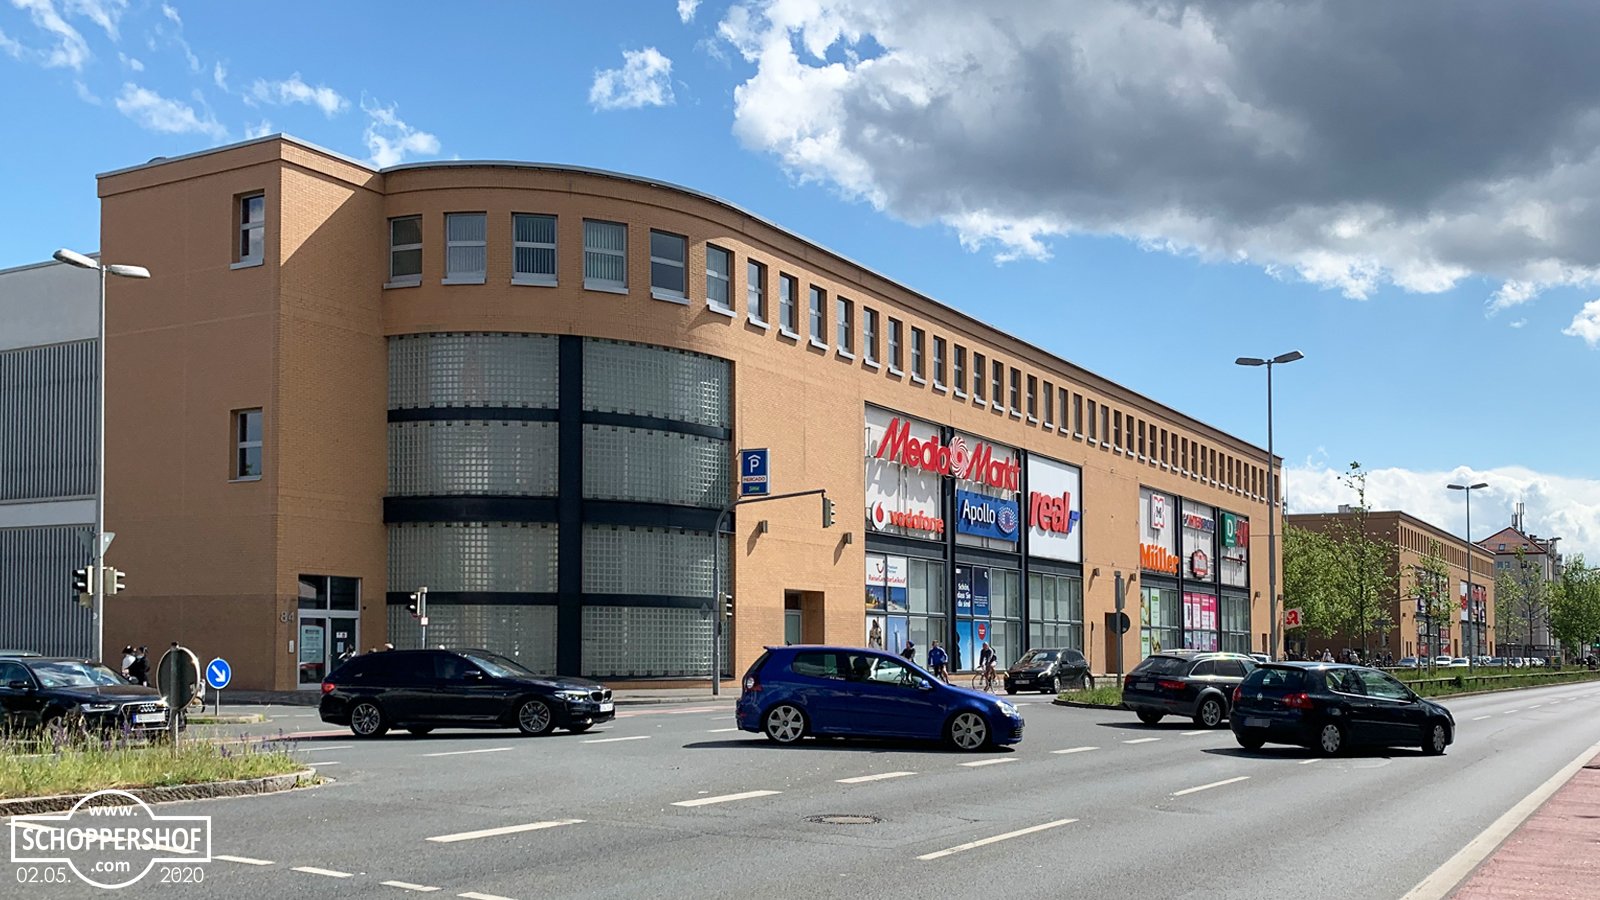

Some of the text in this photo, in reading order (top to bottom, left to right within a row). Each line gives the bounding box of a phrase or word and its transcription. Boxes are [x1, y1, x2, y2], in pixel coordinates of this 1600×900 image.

[750, 459, 759, 473] P
[876, 417, 1020, 491] Media Markt
[889, 507, 944, 534] vodafone
[963, 499, 996, 525] Apollo
[1140, 542, 1179, 575] Müller
[280, 611, 294, 623] 84
